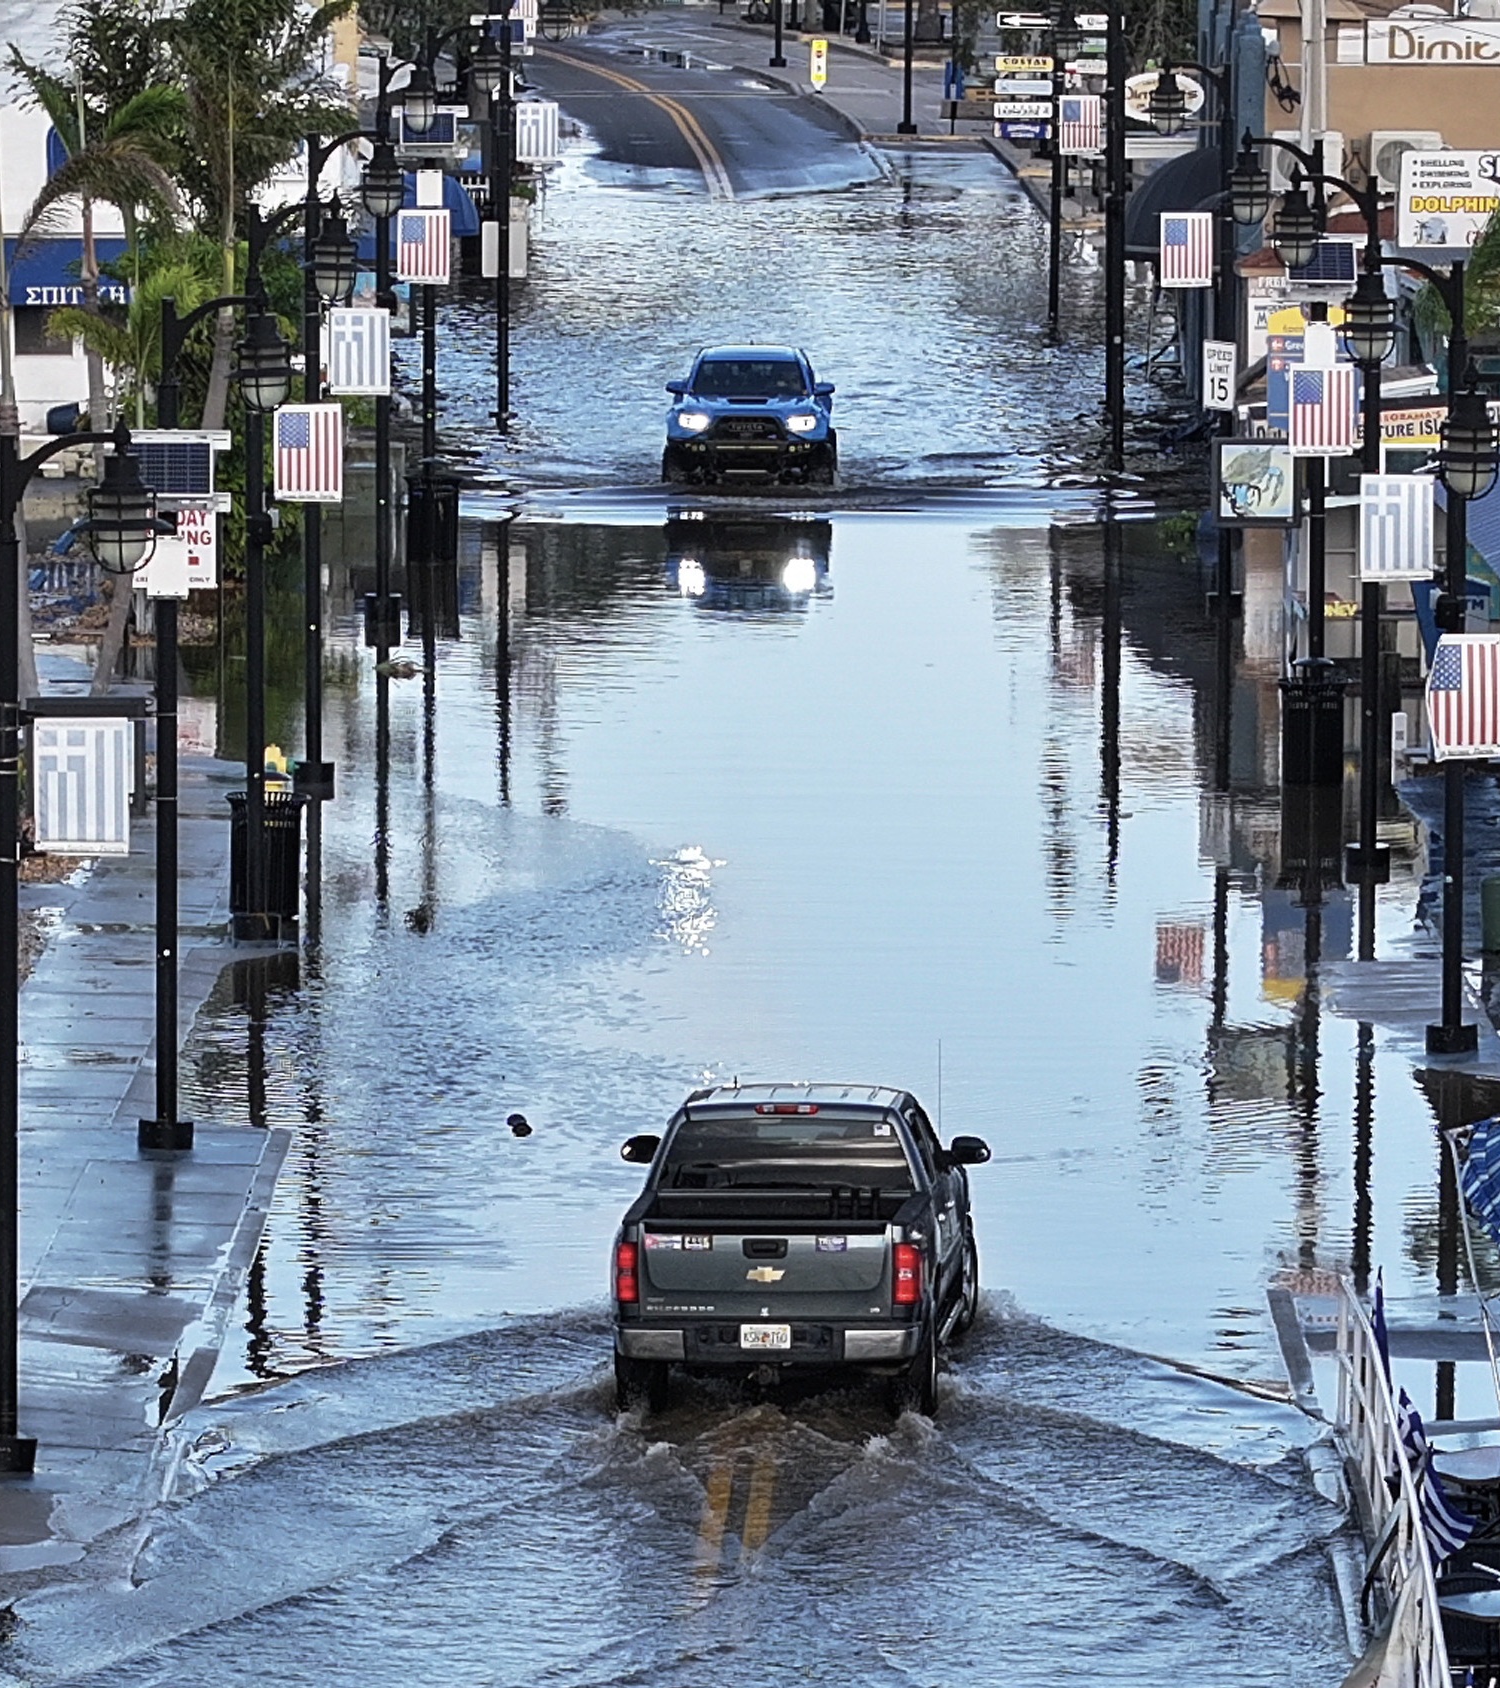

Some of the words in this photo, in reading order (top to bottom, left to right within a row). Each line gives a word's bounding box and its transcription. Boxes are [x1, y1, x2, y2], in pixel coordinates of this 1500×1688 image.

[1410, 195, 1499, 213] DOLPHIN
[1206, 349, 1233, 361] SPEED
[1209, 364, 1229, 374] LIMIT
[1210, 377, 1228, 402] 15
